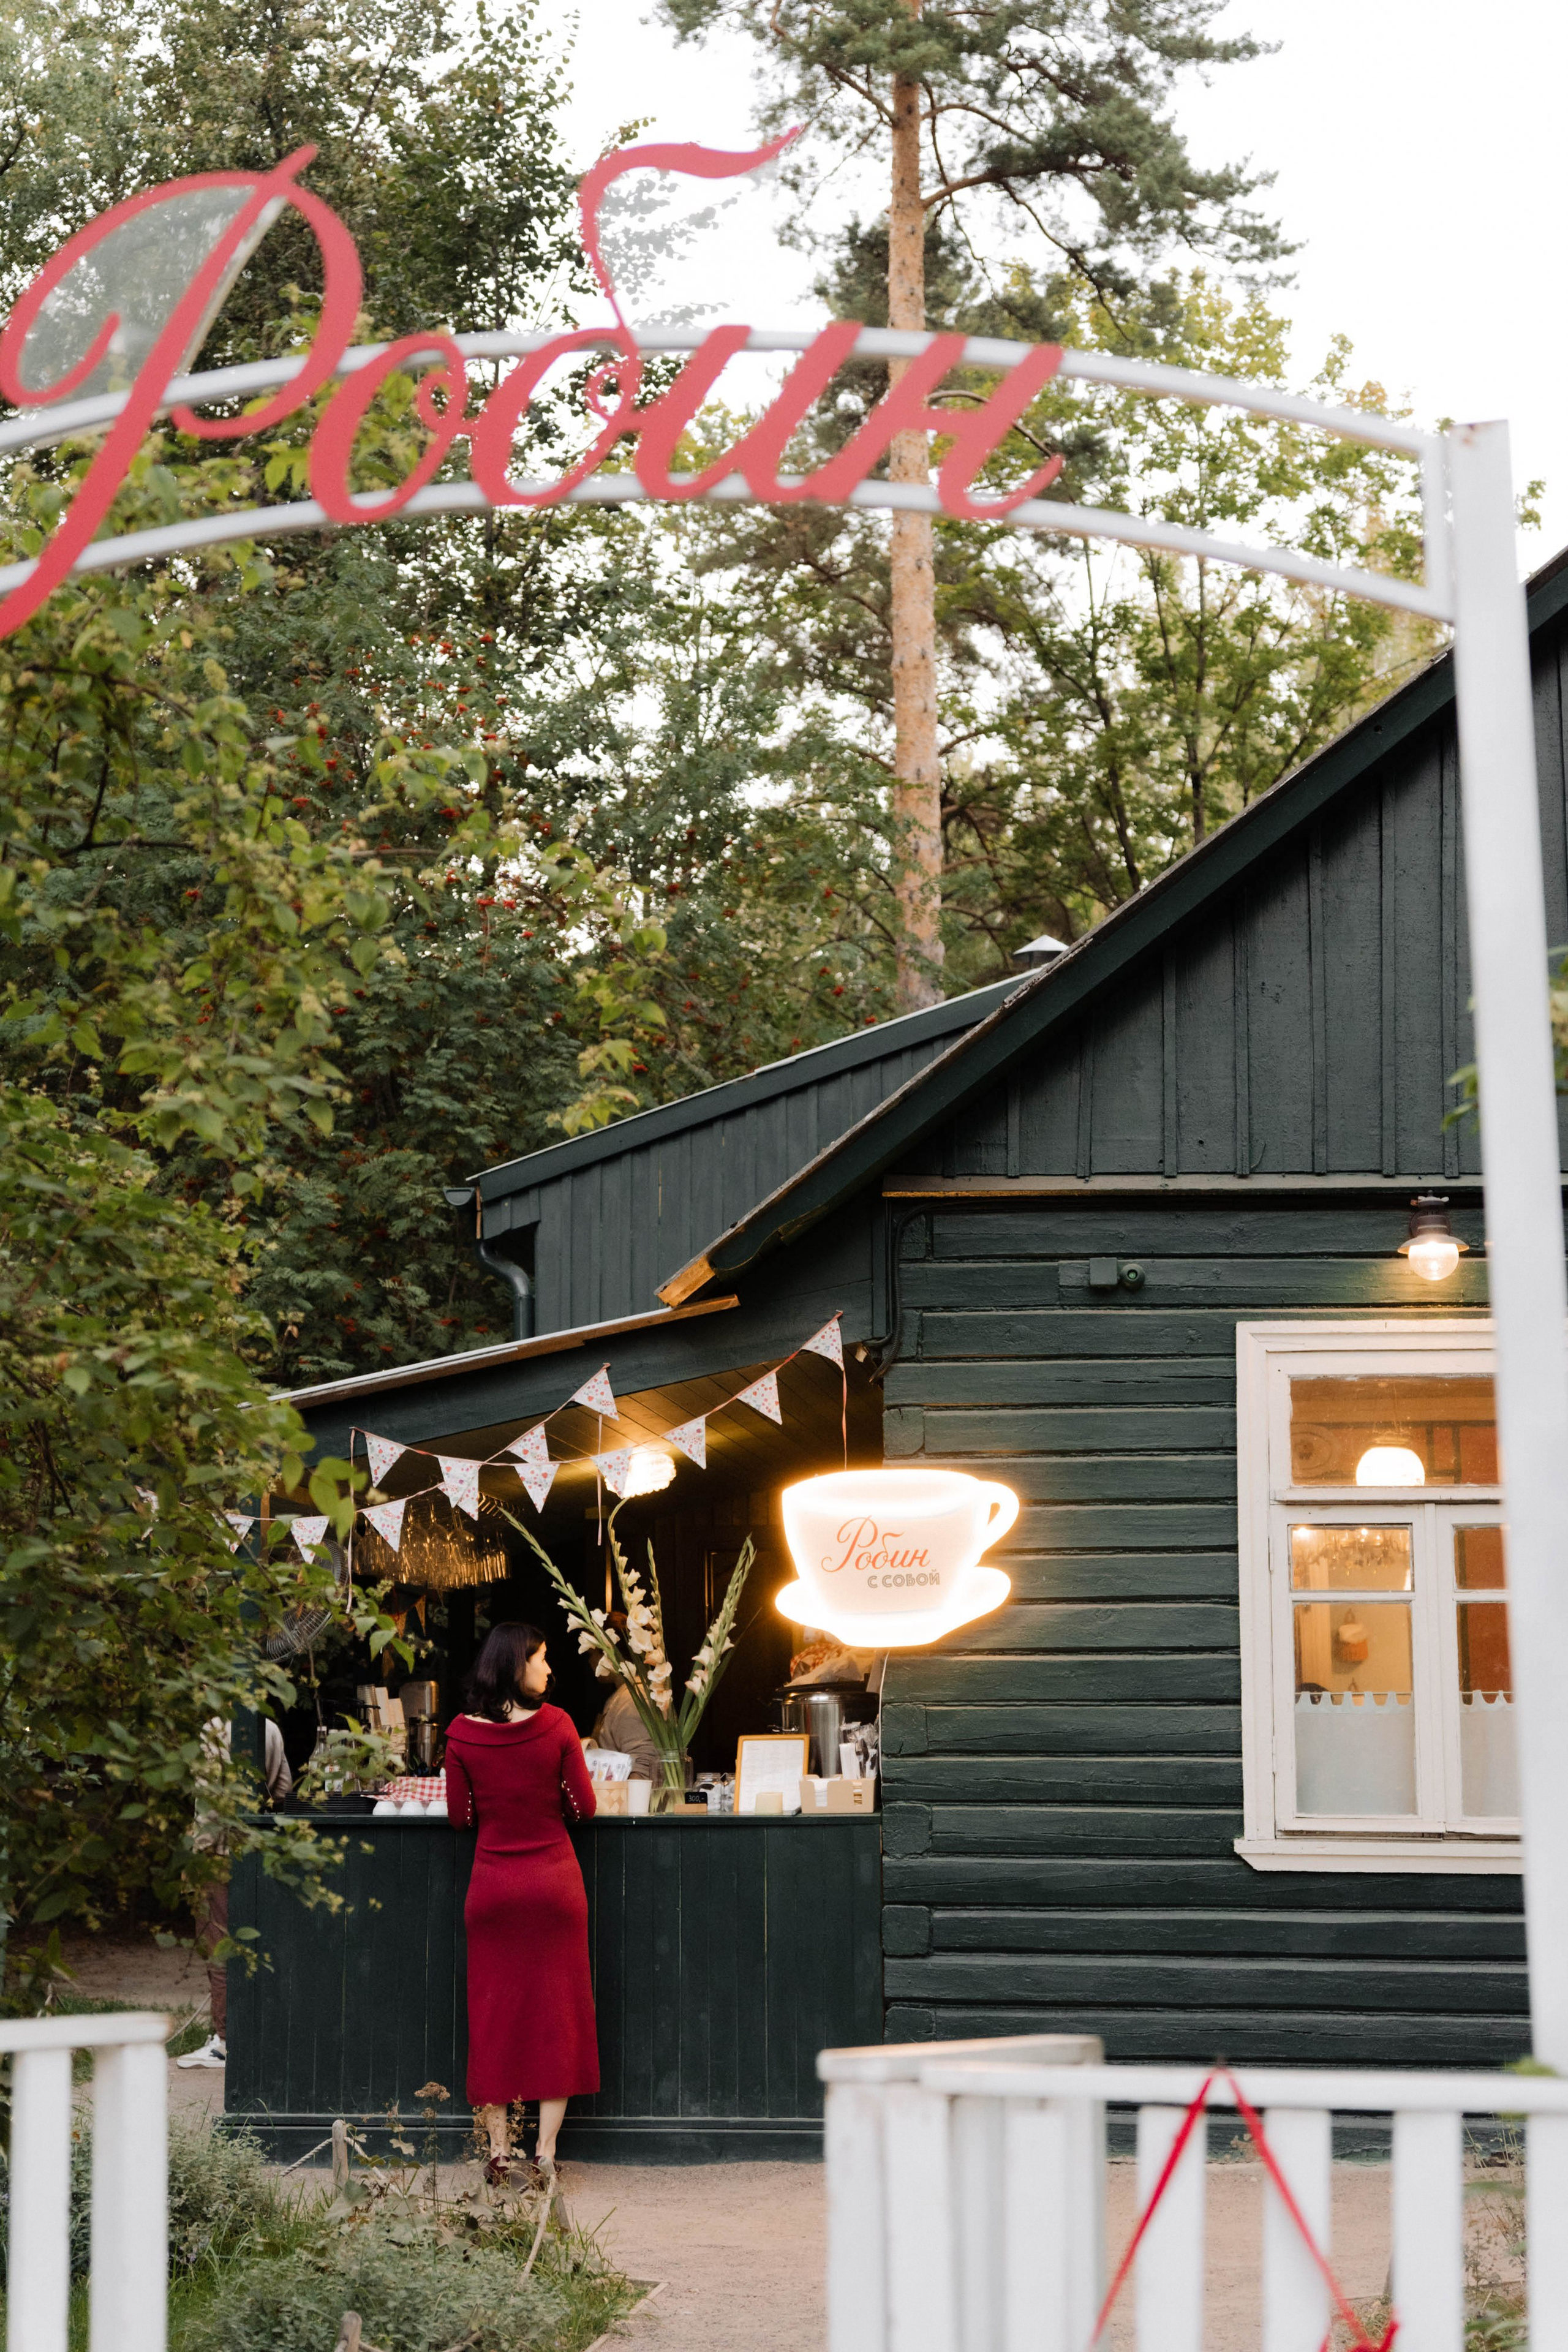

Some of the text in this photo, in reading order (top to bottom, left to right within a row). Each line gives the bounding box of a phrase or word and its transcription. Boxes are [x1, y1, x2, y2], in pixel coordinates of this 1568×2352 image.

[0, 126, 1063, 639] Робин
[821, 1515, 930, 1572] Робин
[882, 1569, 940, 1588] СОБОЙ
